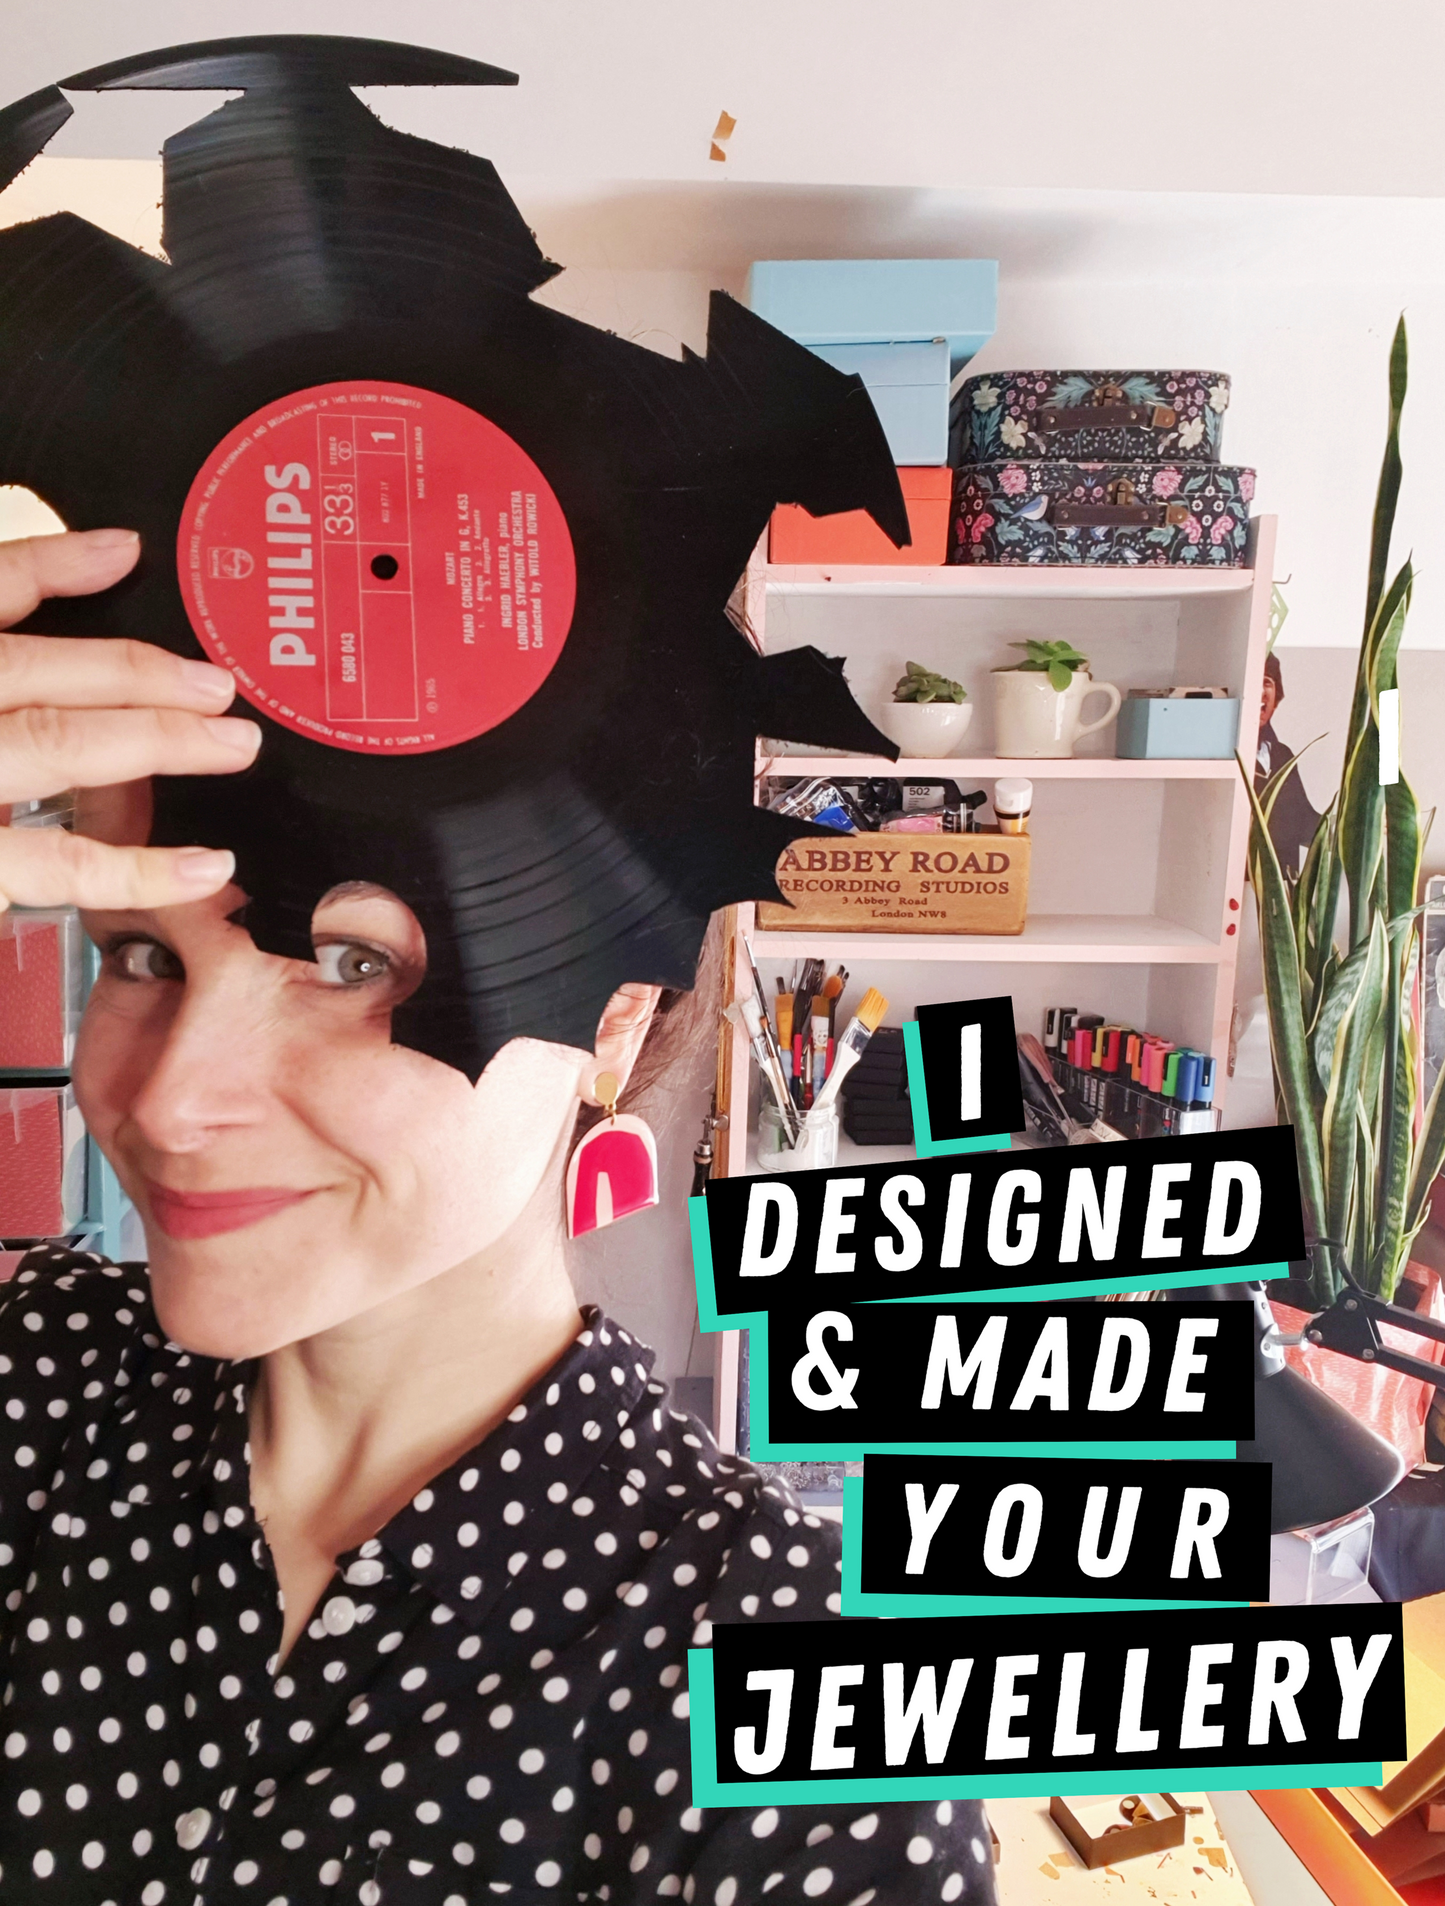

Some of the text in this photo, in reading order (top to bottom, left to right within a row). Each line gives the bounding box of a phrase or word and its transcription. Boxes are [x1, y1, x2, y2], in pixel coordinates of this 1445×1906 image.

[329, 436, 338, 465] STEREO
[371, 432, 396, 443] 1
[414, 426, 424, 460] ENGLAND
[417, 478, 425, 498] MADE
[457, 493, 469, 520] K.453
[459, 541, 471, 552] IN
[264, 462, 316, 666] PHILIPS
[445, 552, 456, 585] MOZART
[498, 512, 512, 628] INGRID HAEBLER, piano
[511, 491, 529, 650] LONDON SYMPHONY ORCHESTRA
[525, 493, 543, 649] Conducted by WITOLD ROWICKI
[460, 557, 473, 608] CONCERTO
[462, 613, 475, 644] PIANO
[340, 632, 357, 683] 6580 043
[909, 787, 930, 796] 502
[779, 848, 1010, 874] ABBEY ROAD
[778, 879, 1009, 894] RECORDING STUDIOS
[842, 896, 928, 907] 3 Abbey Road
[872, 909, 947, 919] London NW8
